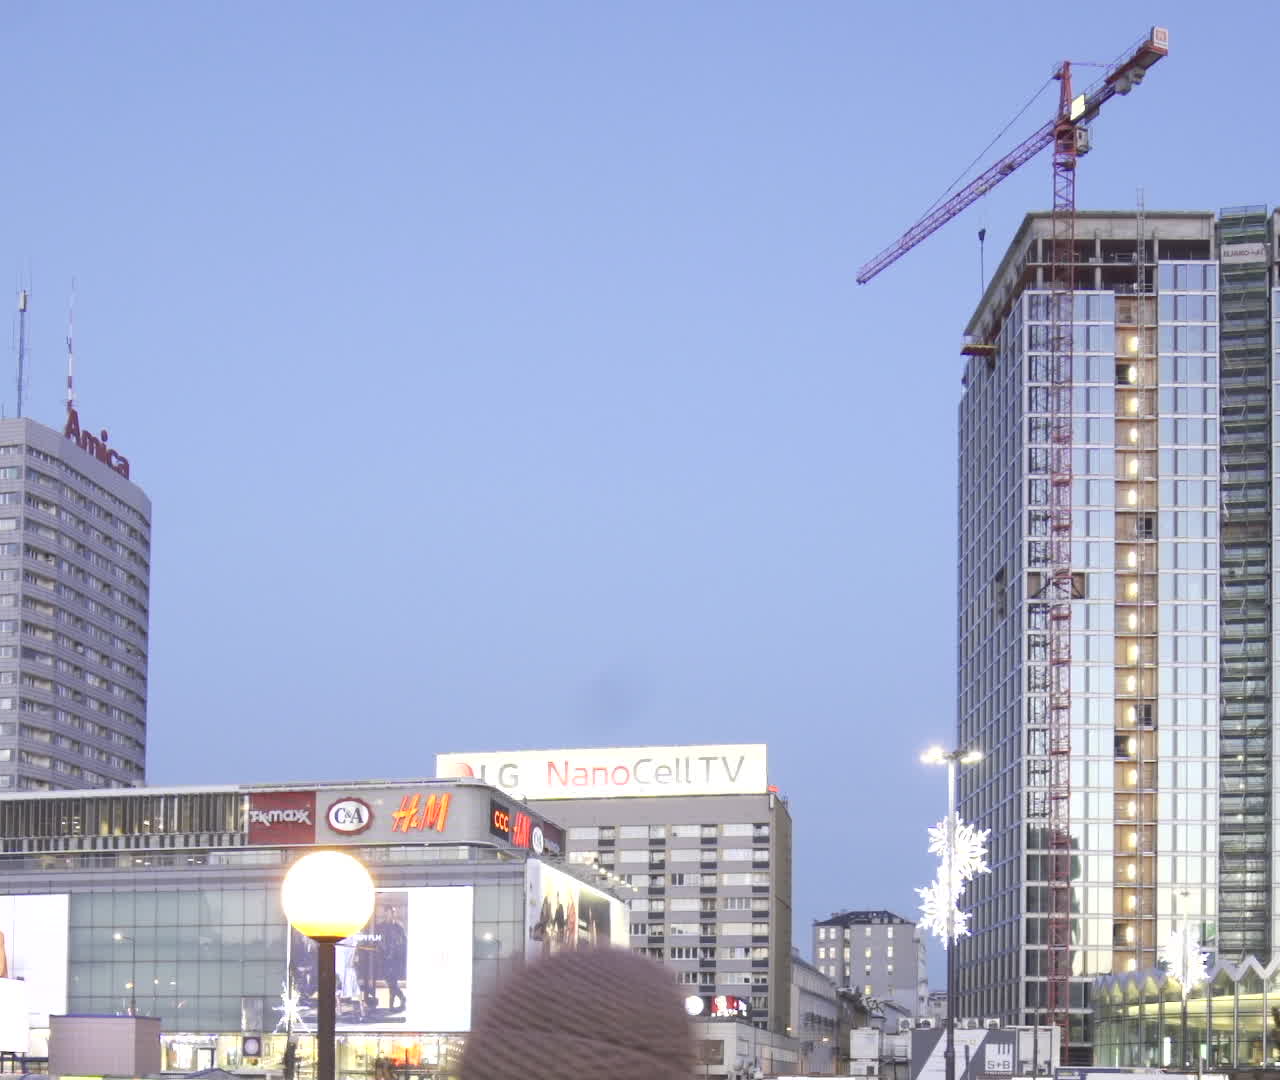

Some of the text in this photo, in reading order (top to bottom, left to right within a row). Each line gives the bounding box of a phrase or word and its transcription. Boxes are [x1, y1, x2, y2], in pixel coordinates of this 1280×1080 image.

[64, 404, 130, 481] Amica
[480, 763, 519, 789] LG
[391, 792, 453, 833] H&M
[494, 810, 509, 833] CCC
